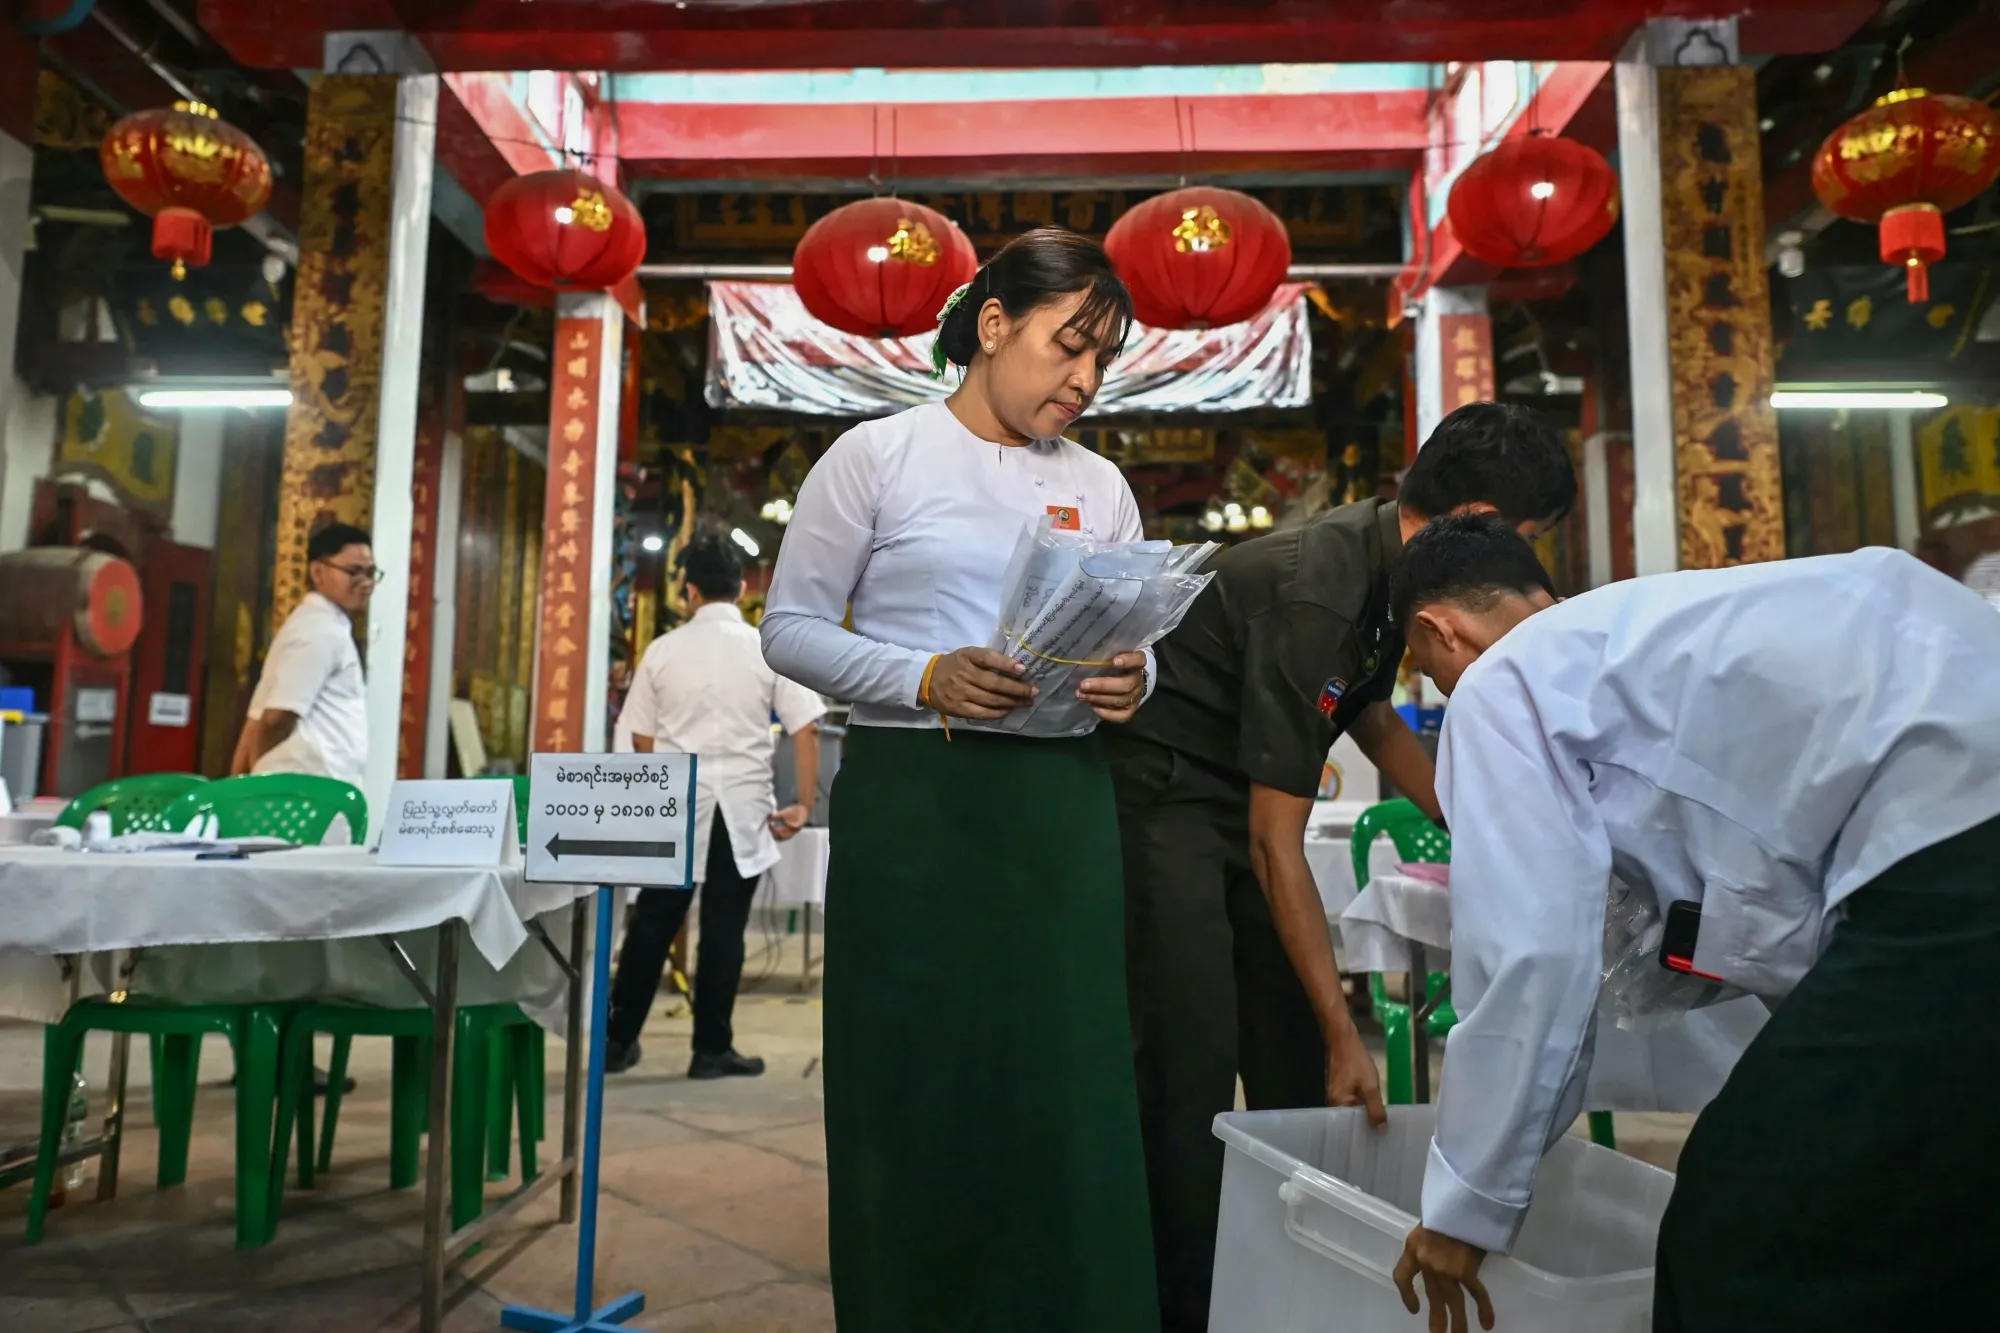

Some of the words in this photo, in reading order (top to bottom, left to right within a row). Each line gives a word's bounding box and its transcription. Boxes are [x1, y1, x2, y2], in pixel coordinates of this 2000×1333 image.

[594, 804, 605, 824] မှ
[610, 804, 655, 817] ၁၈၁၈
[659, 797, 677, 817] ထိ
